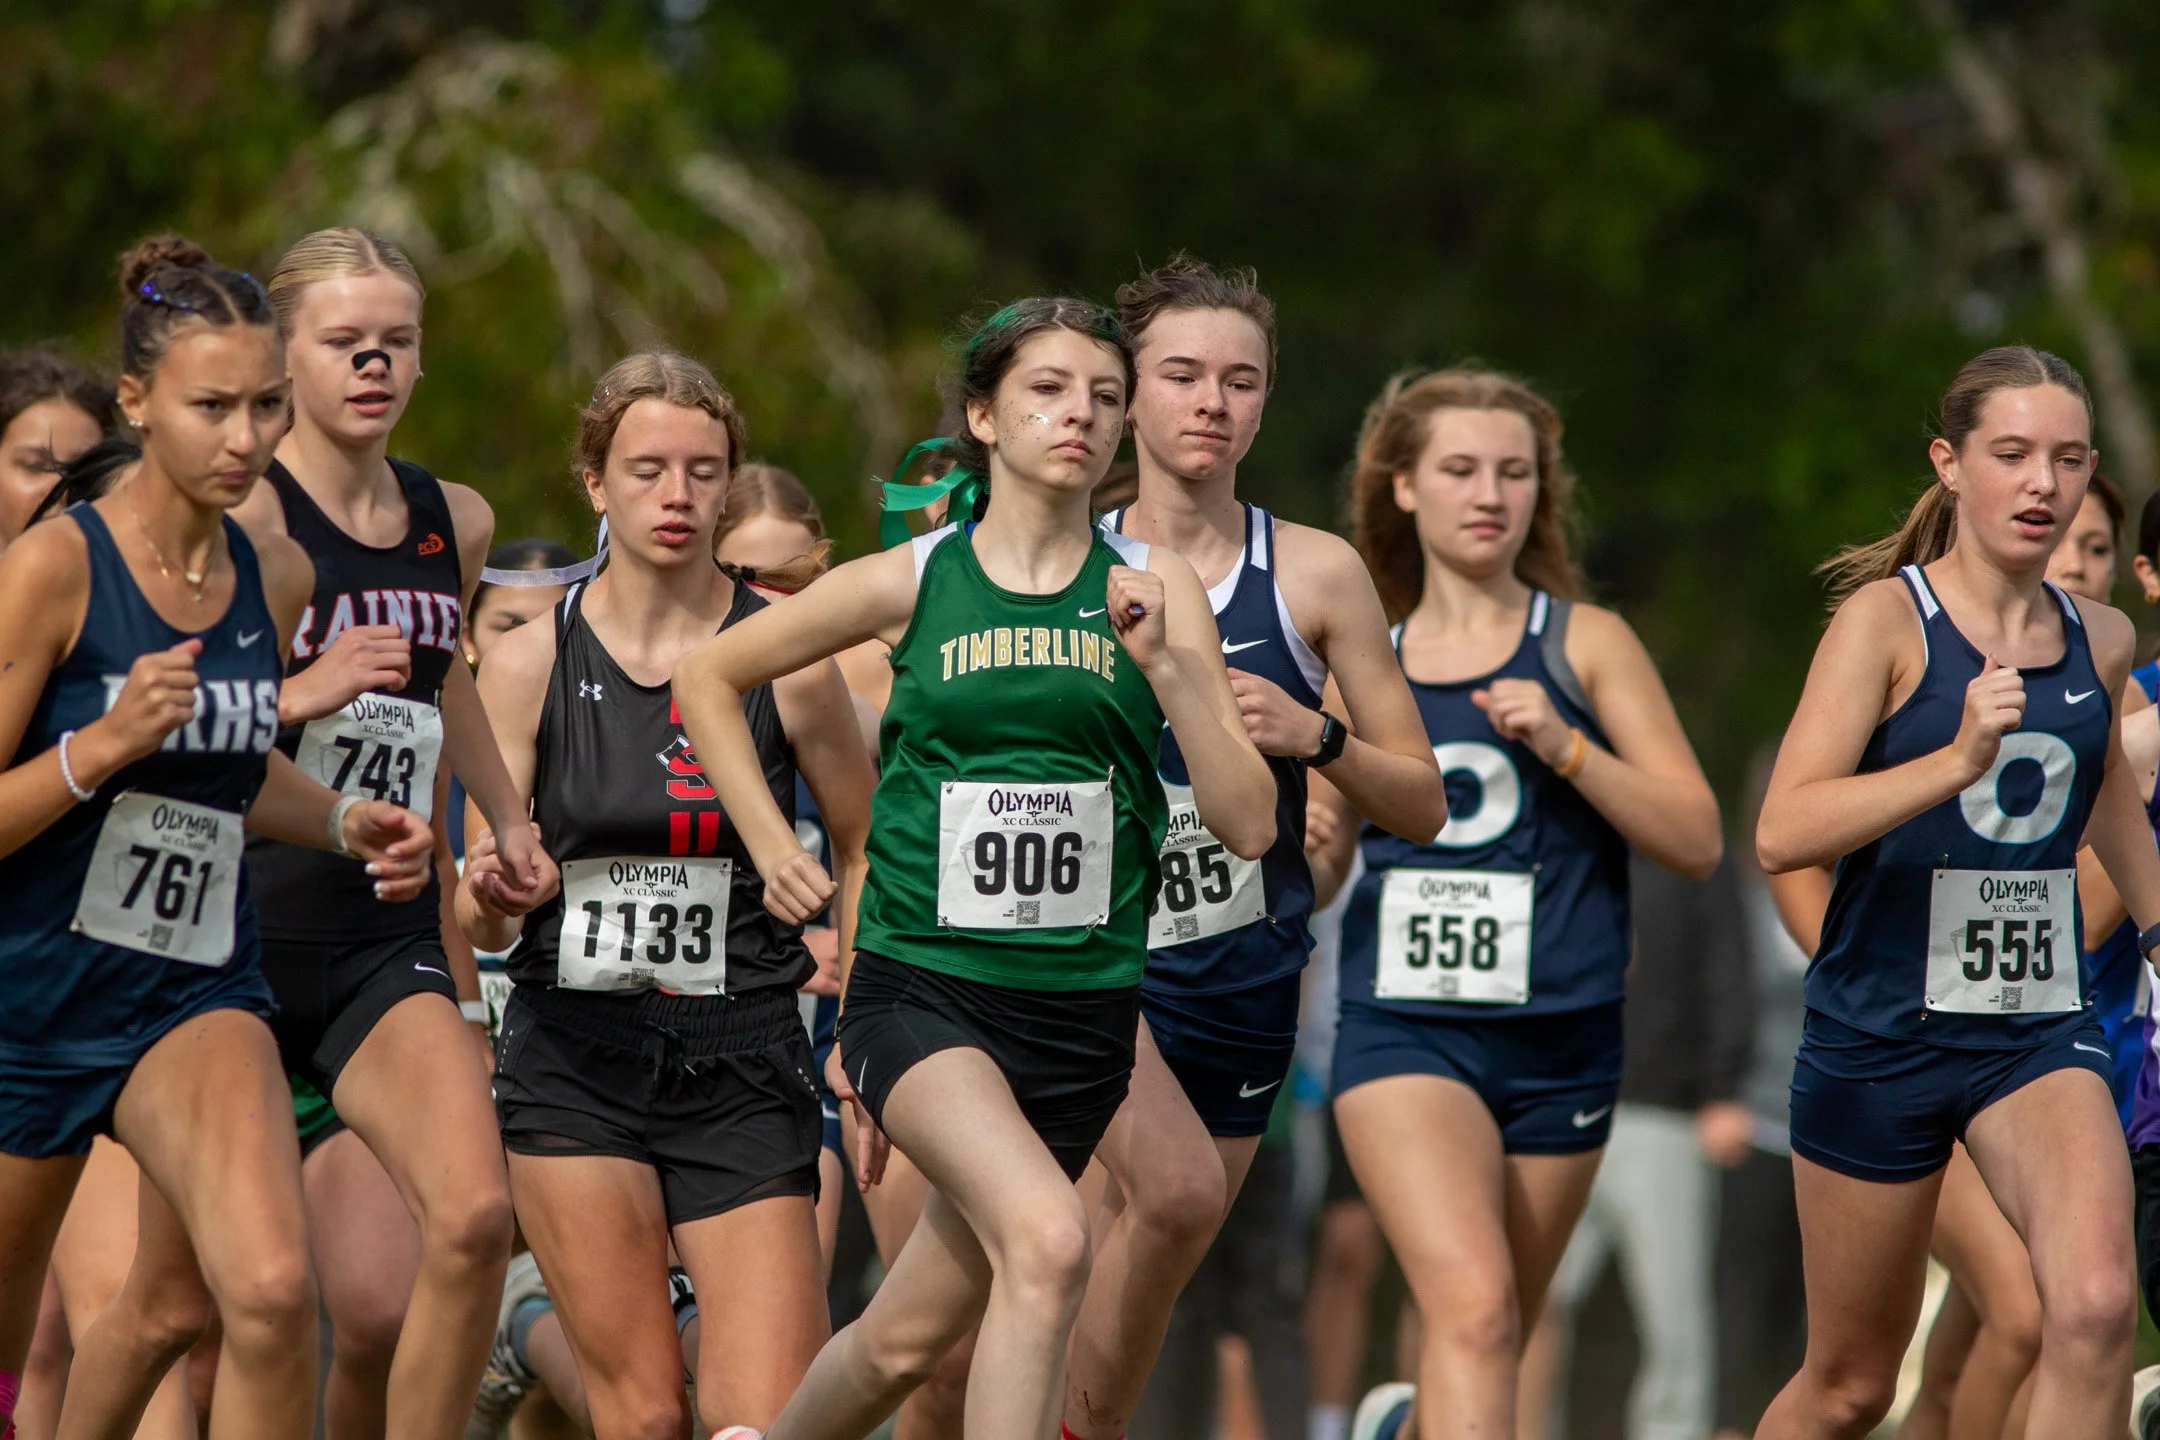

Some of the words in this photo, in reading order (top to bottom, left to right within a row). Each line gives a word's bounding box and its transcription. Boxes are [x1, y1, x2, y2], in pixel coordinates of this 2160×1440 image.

[292, 589, 462, 659] AINIE
[940, 627, 1115, 683] TIMBERLINE
[351, 698, 415, 733] OLYMPIA
[362, 724, 375, 735] XC
[376, 726, 407, 740] CLASSIC
[331, 734, 416, 810] 743
[1959, 731, 2076, 844] O
[152, 803, 219, 845] OLYMPIA
[988, 788, 1073, 817] OLYMPIA
[1002, 817, 1017, 826] XC
[1018, 817, 1062, 826] CLASSIC
[120, 844, 213, 926] 761
[609, 861, 689, 889] OLYMPIA
[974, 831, 1083, 896] 906
[1150, 843, 1233, 918] 85
[1979, 876, 2049, 904] OLYMPIA
[622, 887, 636, 896] XC
[637, 888, 678, 898] CLASSIC
[1991, 904, 2005, 913] XC
[2006, 904, 2042, 913] CLASSIC
[582, 900, 714, 964] 1133
[1406, 914, 1500, 972] 558
[1962, 919, 2054, 982] 555
